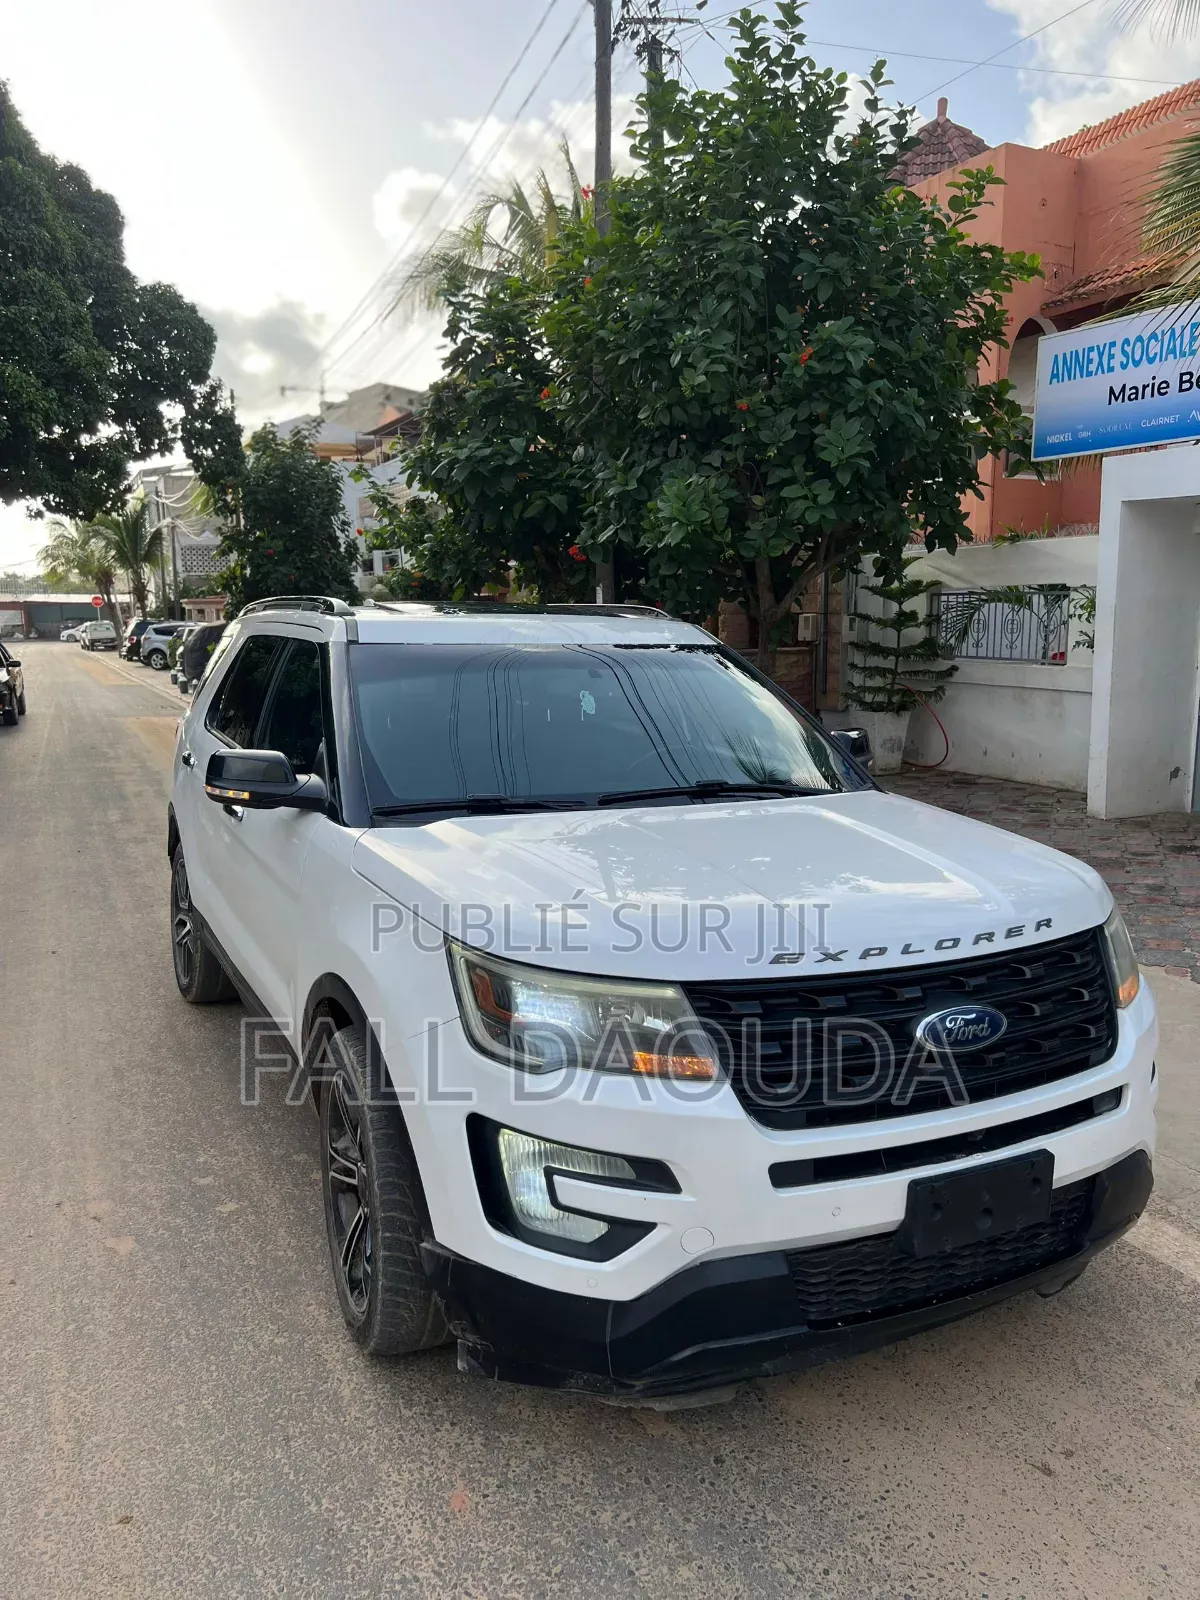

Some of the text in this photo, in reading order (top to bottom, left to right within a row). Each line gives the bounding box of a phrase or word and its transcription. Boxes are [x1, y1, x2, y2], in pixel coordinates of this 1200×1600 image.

[1049, 321, 1200, 385] ANNEXE SOCIALE
[1107, 376, 1170, 405] Marie
[1046, 432, 1073, 444] NICKEL
[1077, 430, 1092, 439] GRH
[1140, 414, 1181, 428] CLAIRNET
[768, 917, 1054, 965] EXPLORER
[944, 1012, 992, 1042] Ford
